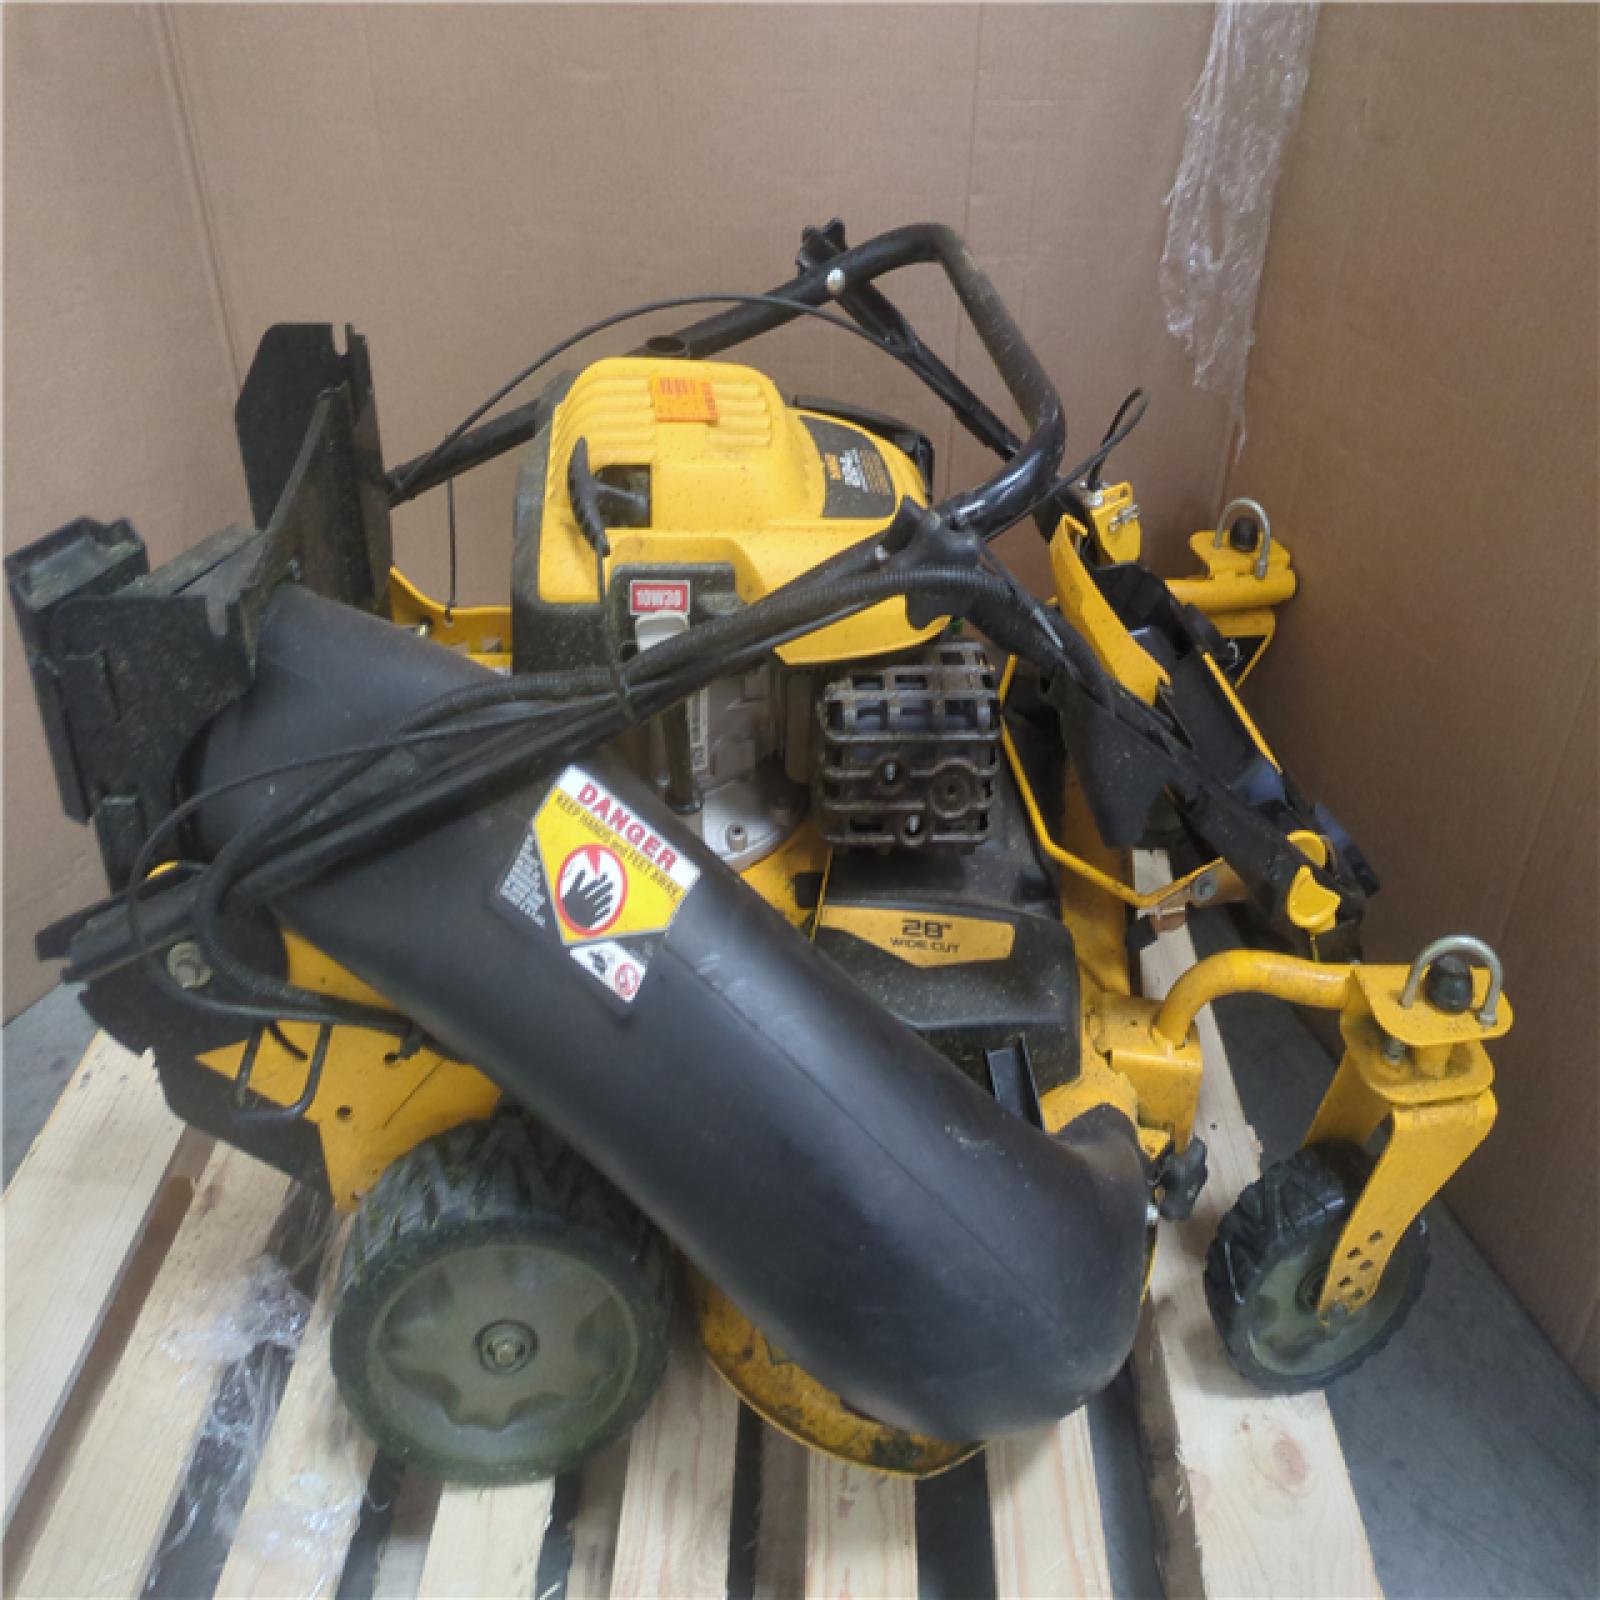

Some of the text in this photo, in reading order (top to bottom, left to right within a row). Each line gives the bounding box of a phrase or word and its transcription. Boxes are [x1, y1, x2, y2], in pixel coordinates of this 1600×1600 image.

[577, 782, 678, 871] DANGER
[902, 919, 953, 938] 28"
[889, 936, 961, 953] WIDE CUT
